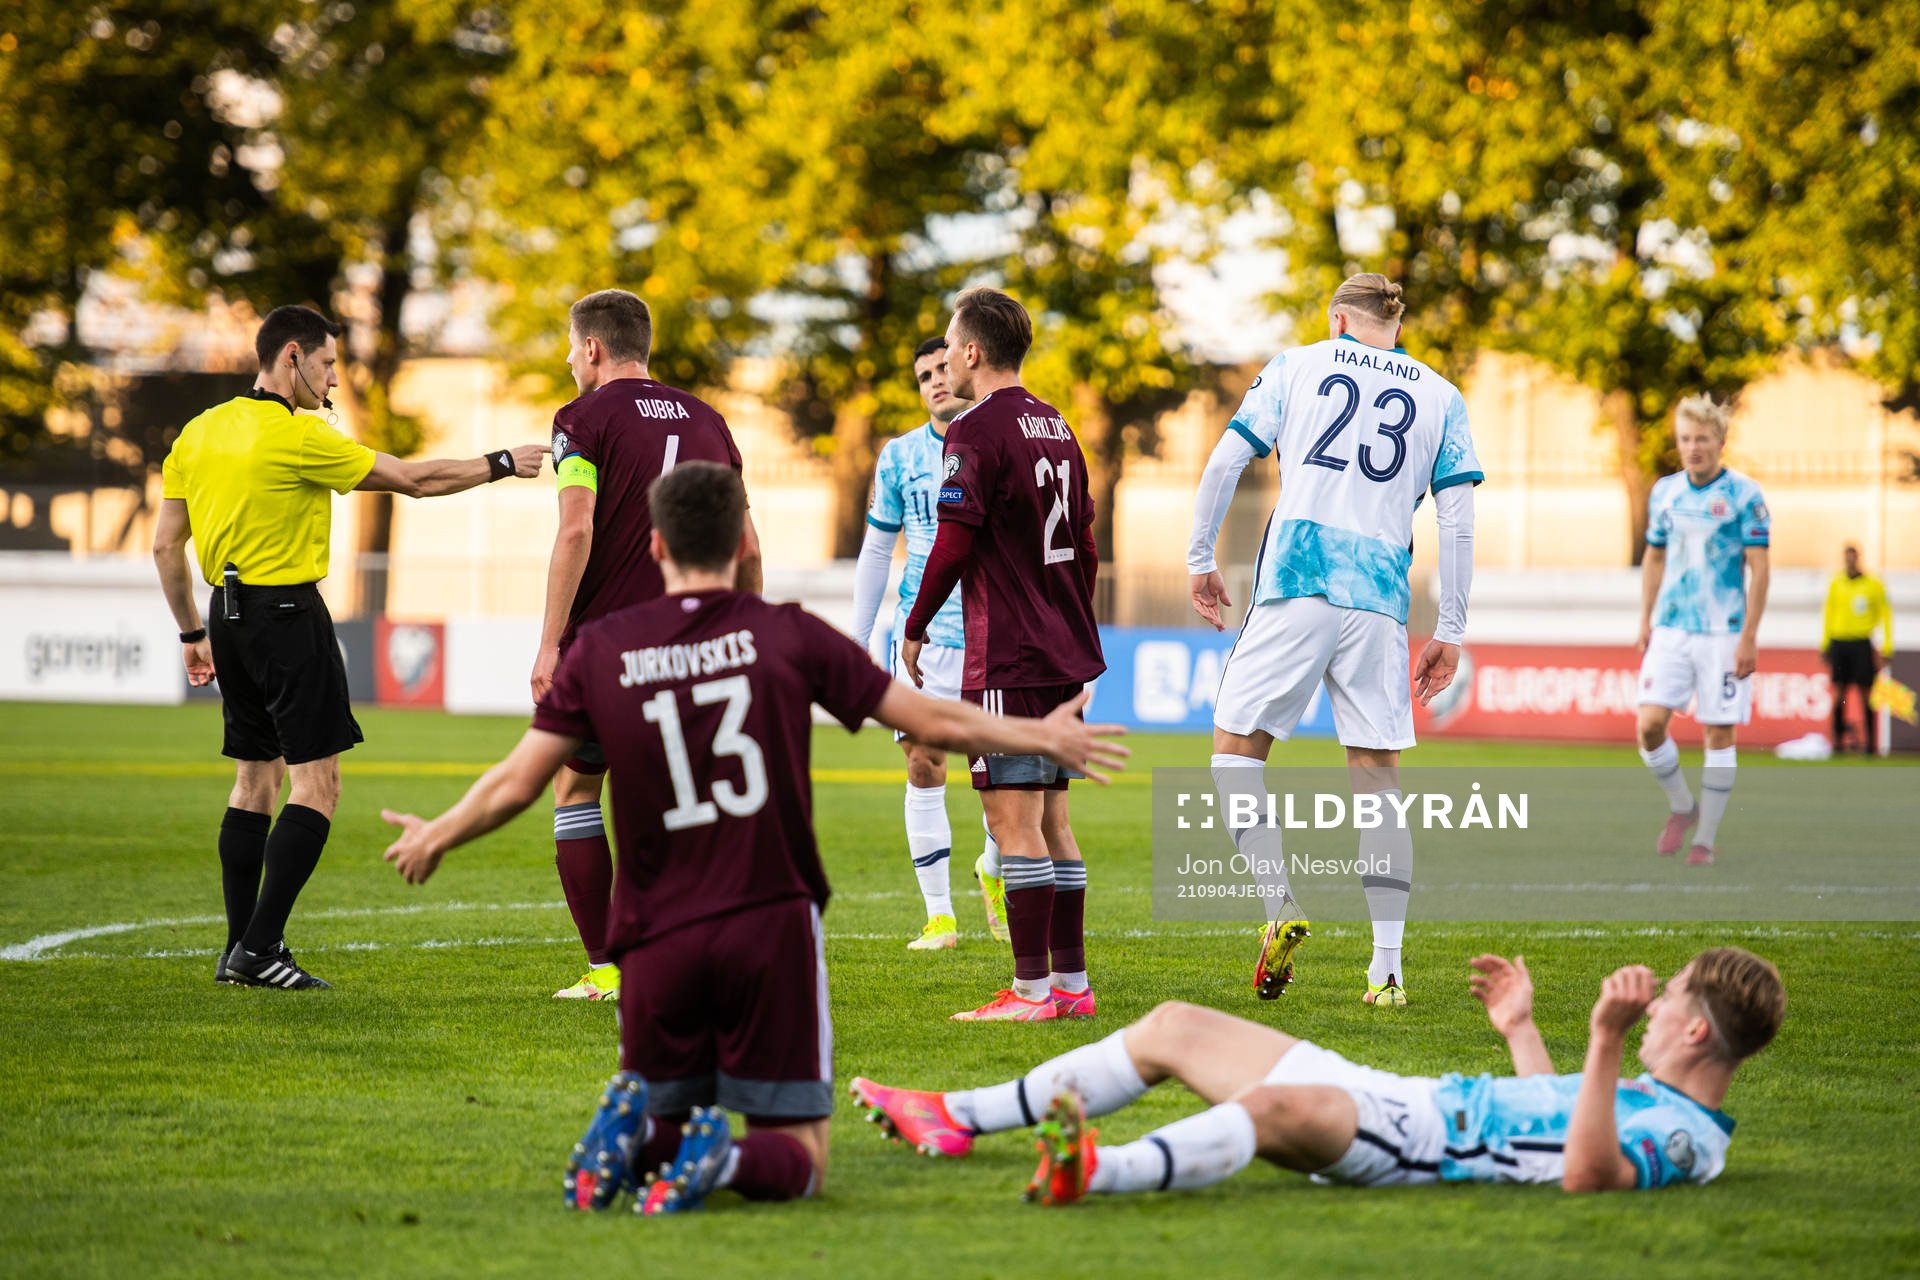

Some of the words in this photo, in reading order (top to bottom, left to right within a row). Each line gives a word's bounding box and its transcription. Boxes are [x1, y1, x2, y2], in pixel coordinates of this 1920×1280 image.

[1334, 348, 1421, 382] HAALAND
[635, 398, 690, 419] DUBRA
[1302, 373, 1417, 483] 23
[910, 490, 931, 525] 11
[938, 491, 962, 499] ESPECT
[1034, 456, 1075, 566] 21
[618, 629, 757, 688] JURKOVSKIS
[1722, 671, 1737, 700] 5
[642, 674, 769, 832] 13
